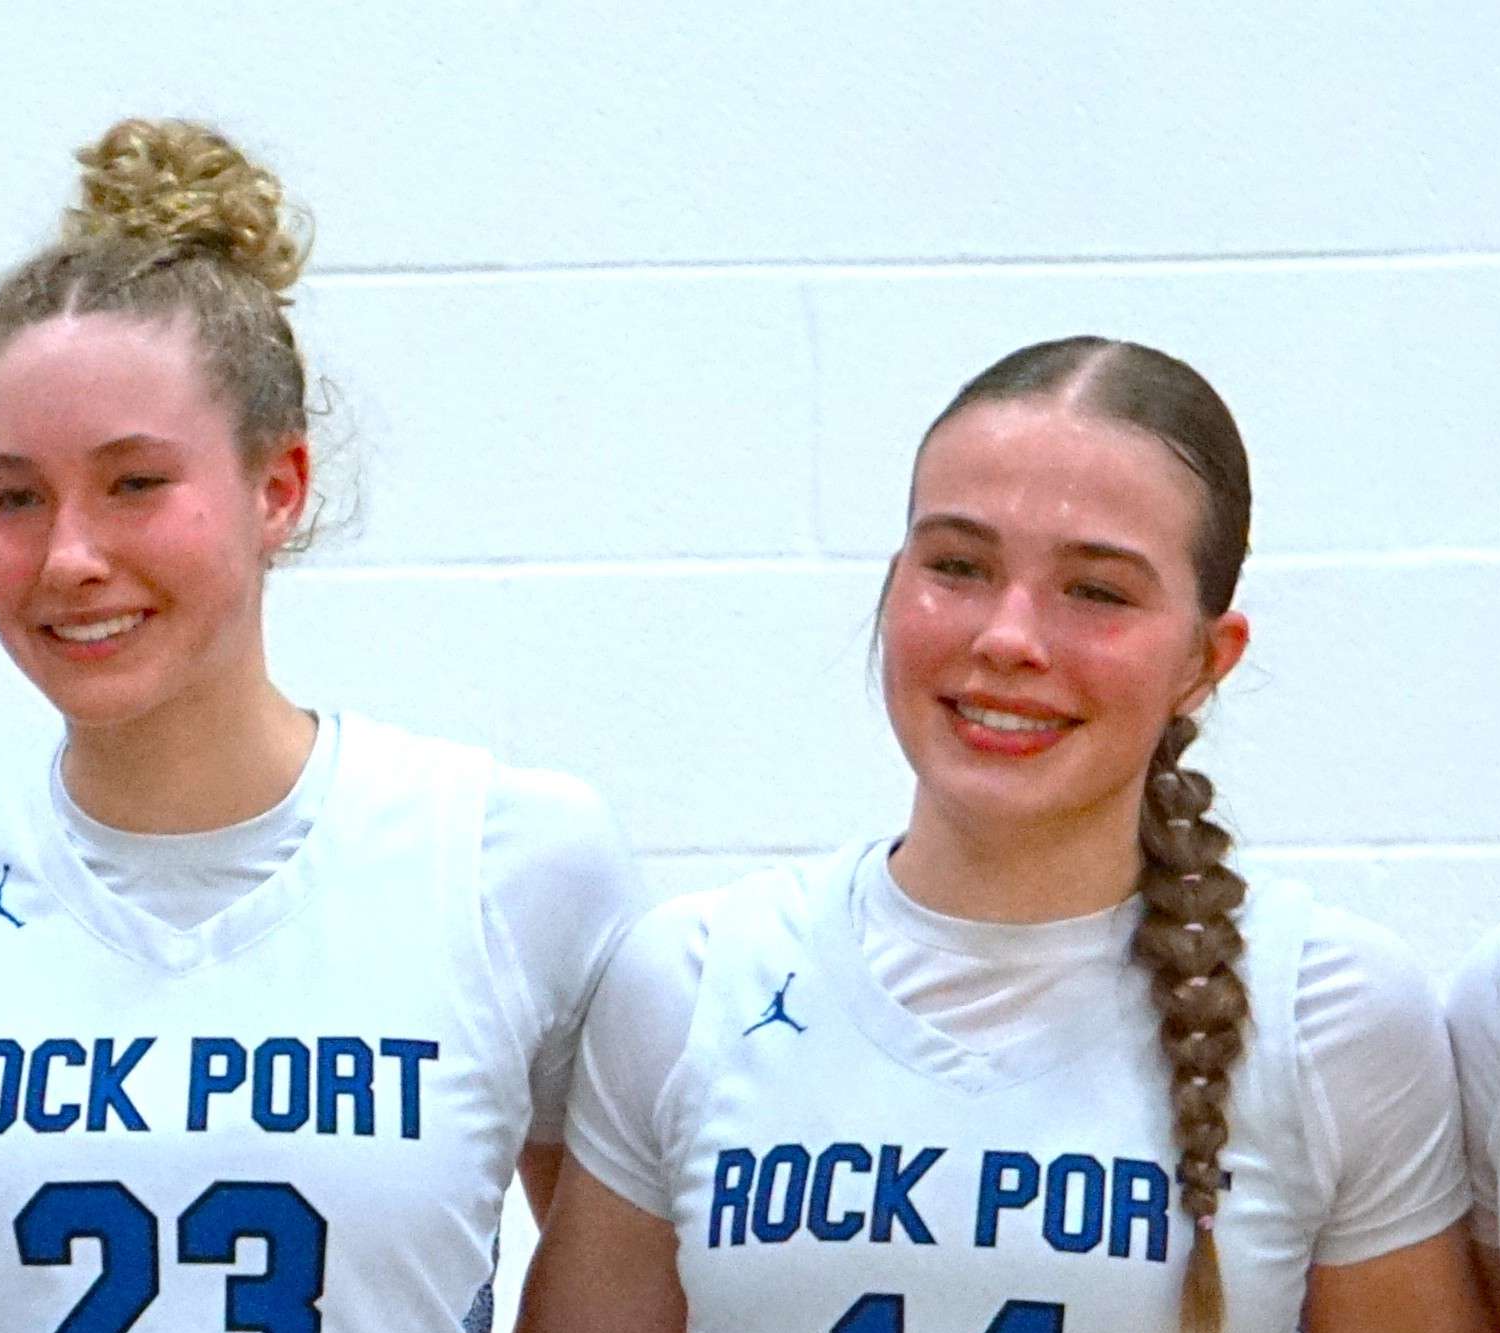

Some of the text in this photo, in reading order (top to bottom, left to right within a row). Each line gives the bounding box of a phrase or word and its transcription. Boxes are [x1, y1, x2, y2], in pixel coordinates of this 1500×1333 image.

[186, 1036, 439, 1140] PORT
[708, 1142, 1231, 1262] ROCK POR
